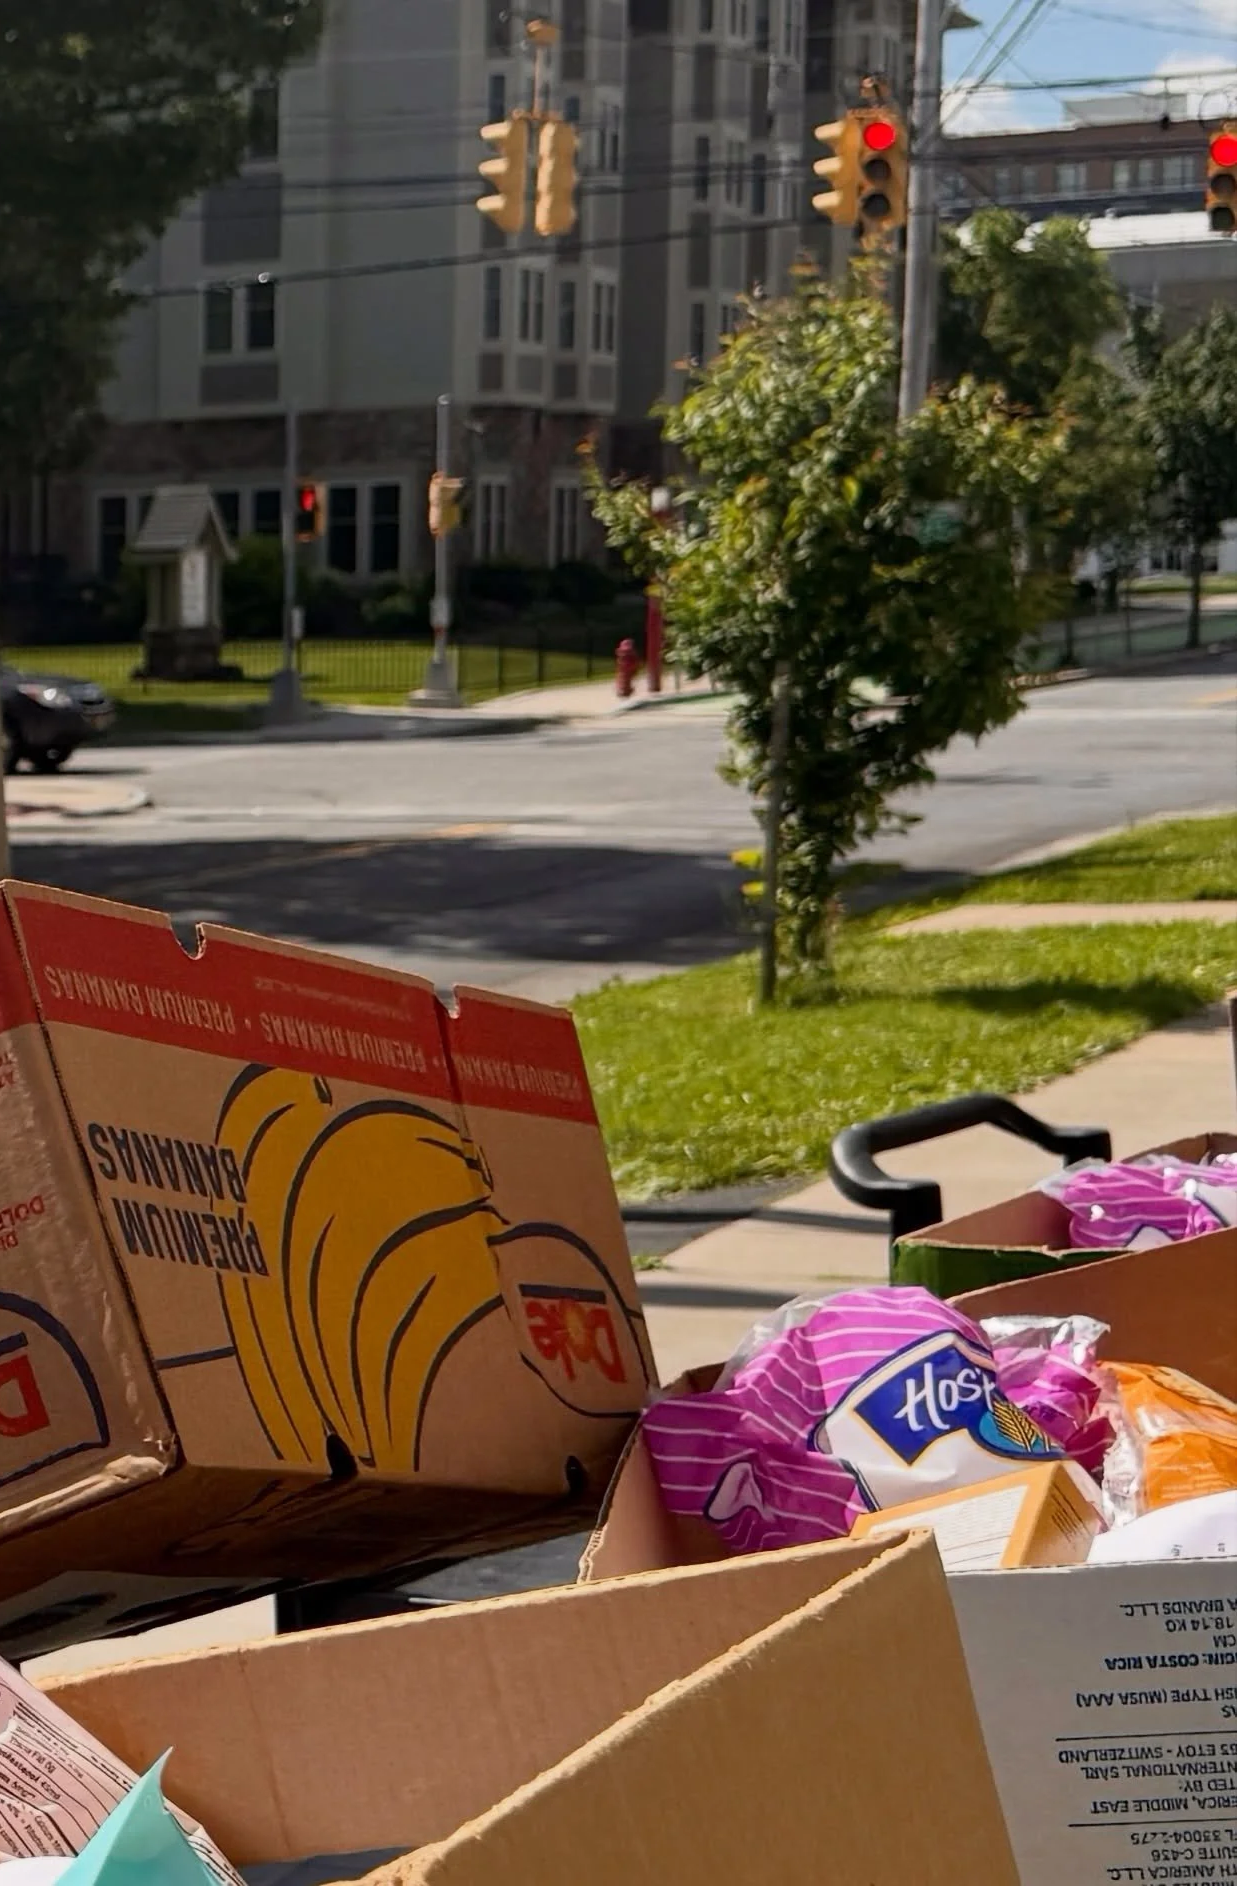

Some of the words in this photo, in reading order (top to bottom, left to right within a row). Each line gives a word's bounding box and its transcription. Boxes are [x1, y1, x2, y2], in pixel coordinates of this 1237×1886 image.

[46, 966, 144, 1015] BANANAS
[148, 987, 235, 1034] PREMIUM
[261, 1014, 348, 1057] BANANAS
[348, 1031, 426, 1073] PREMIUM
[94, 1125, 243, 1201] BANANAS
[116, 1200, 266, 1275] PREMIUM
[525, 1300, 627, 1384] Dole
[1163, 1599, 1224, 1615] BRANDS
[1104, 1655, 1143, 1671] RICA
[1145, 1653, 1199, 1668] COSTA
[1119, 1690, 1168, 1706] (MUSA
[1171, 1688, 1212, 1703] TYPE
[1058, 1747, 1163, 1764] SWITZERLAND
[1176, 1744, 1217, 1758] ETOY
[1179, 1779, 1203, 1793] BY:
[1090, 1799, 1129, 1814] EAST
[1132, 1797, 1189, 1813] MIDDLE
[1148, 1864, 1215, 1880] AMERICA
